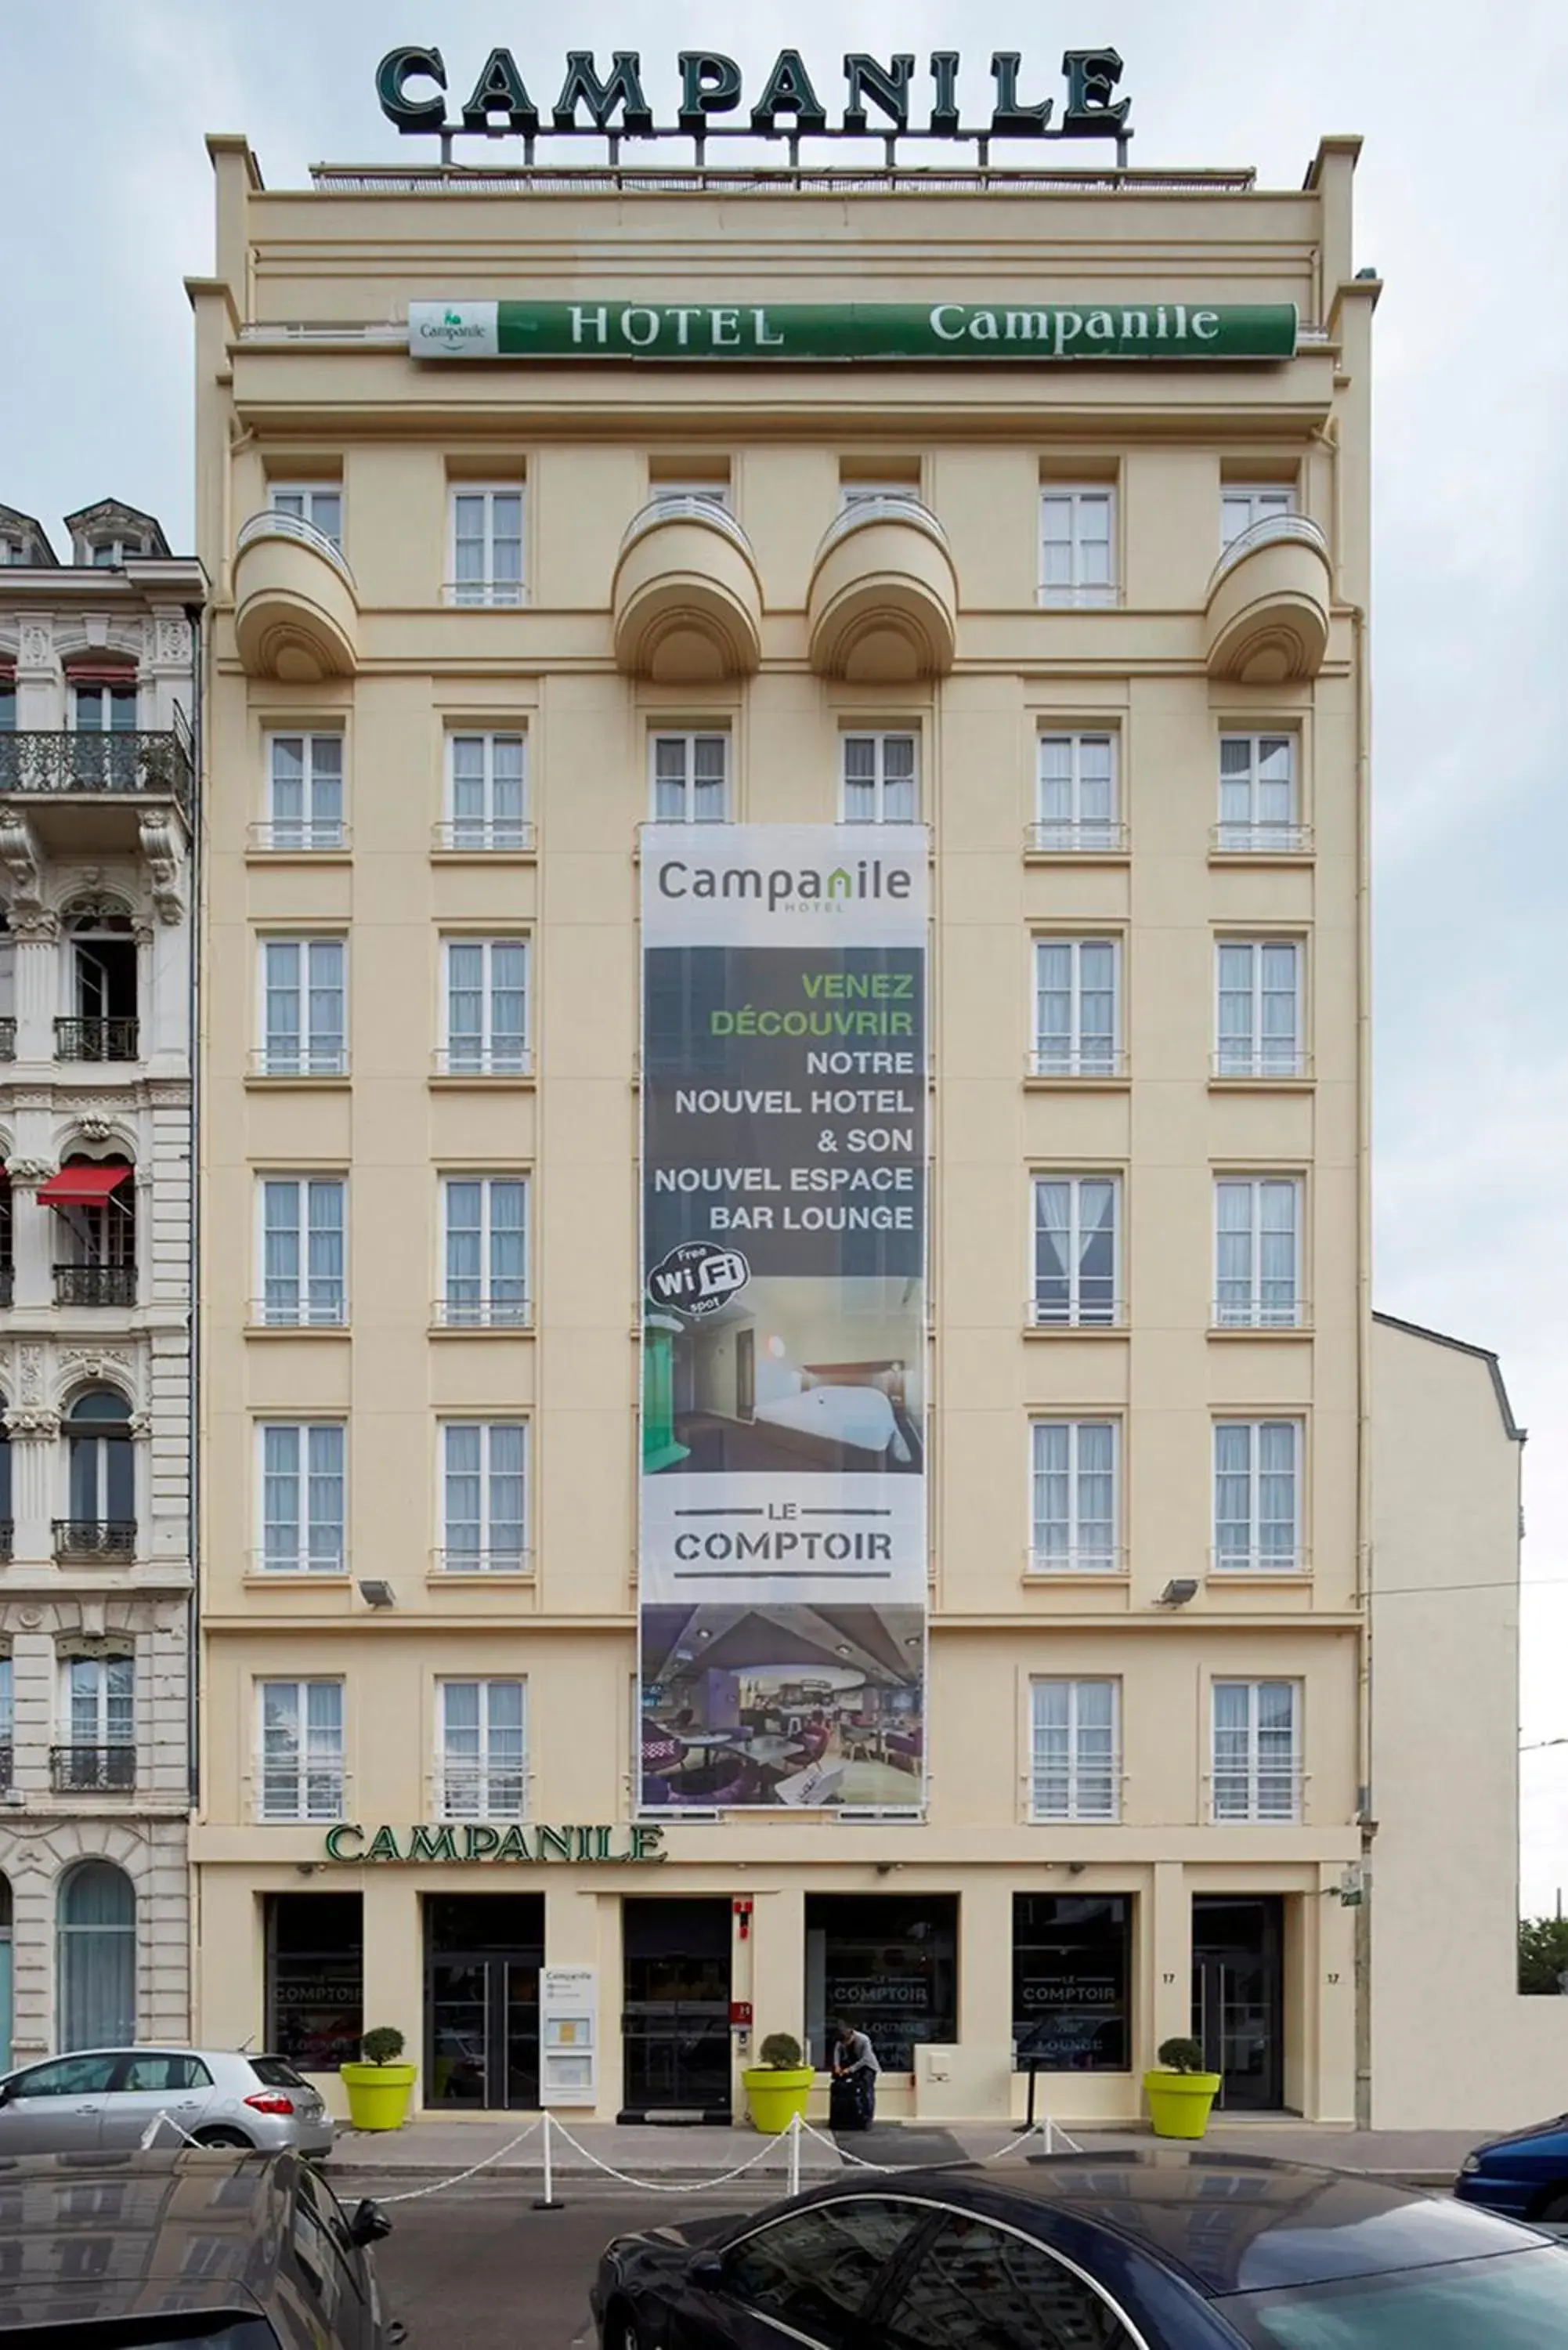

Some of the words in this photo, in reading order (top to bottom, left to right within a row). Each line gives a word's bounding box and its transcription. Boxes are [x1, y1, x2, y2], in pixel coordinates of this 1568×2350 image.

[375, 46, 1133, 135] CAMPANILE
[420, 324, 486, 341] Campanile
[567, 306, 783, 345] HOTEL
[930, 305, 1219, 355] Campanile
[659, 860, 911, 912] Campanile
[785, 902, 844, 913] HOTEL
[802, 974, 913, 999] VENEZ
[711, 1006, 913, 1036] DÉCOUVRIR
[807, 1052, 913, 1074] NOTRE
[676, 1090, 801, 1113] NOUVEL
[811, 1090, 913, 1113] HOTEL
[818, 1130, 838, 1152] &
[847, 1129, 913, 1152] SON
[655, 1168, 781, 1191] NOUVEL
[790, 1168, 913, 1191] ESPACE
[710, 1206, 774, 1230] BAR
[784, 1206, 913, 1230] LOUNGE
[677, 1247, 706, 1261] Free
[690, 1297, 720, 1313] spot
[768, 1502, 797, 1520] LE
[674, 1531, 891, 1561] COMPTOIR
[325, 1824, 669, 1863] CAMPANILE
[1061, 1975, 1075, 1984] LE
[1163, 1973, 1175, 1984] 17
[1328, 1973, 1339, 1984] 17
[834, 1987, 928, 2001] COMPTOIR
[1023, 1987, 1115, 2001] COMPTOIR
